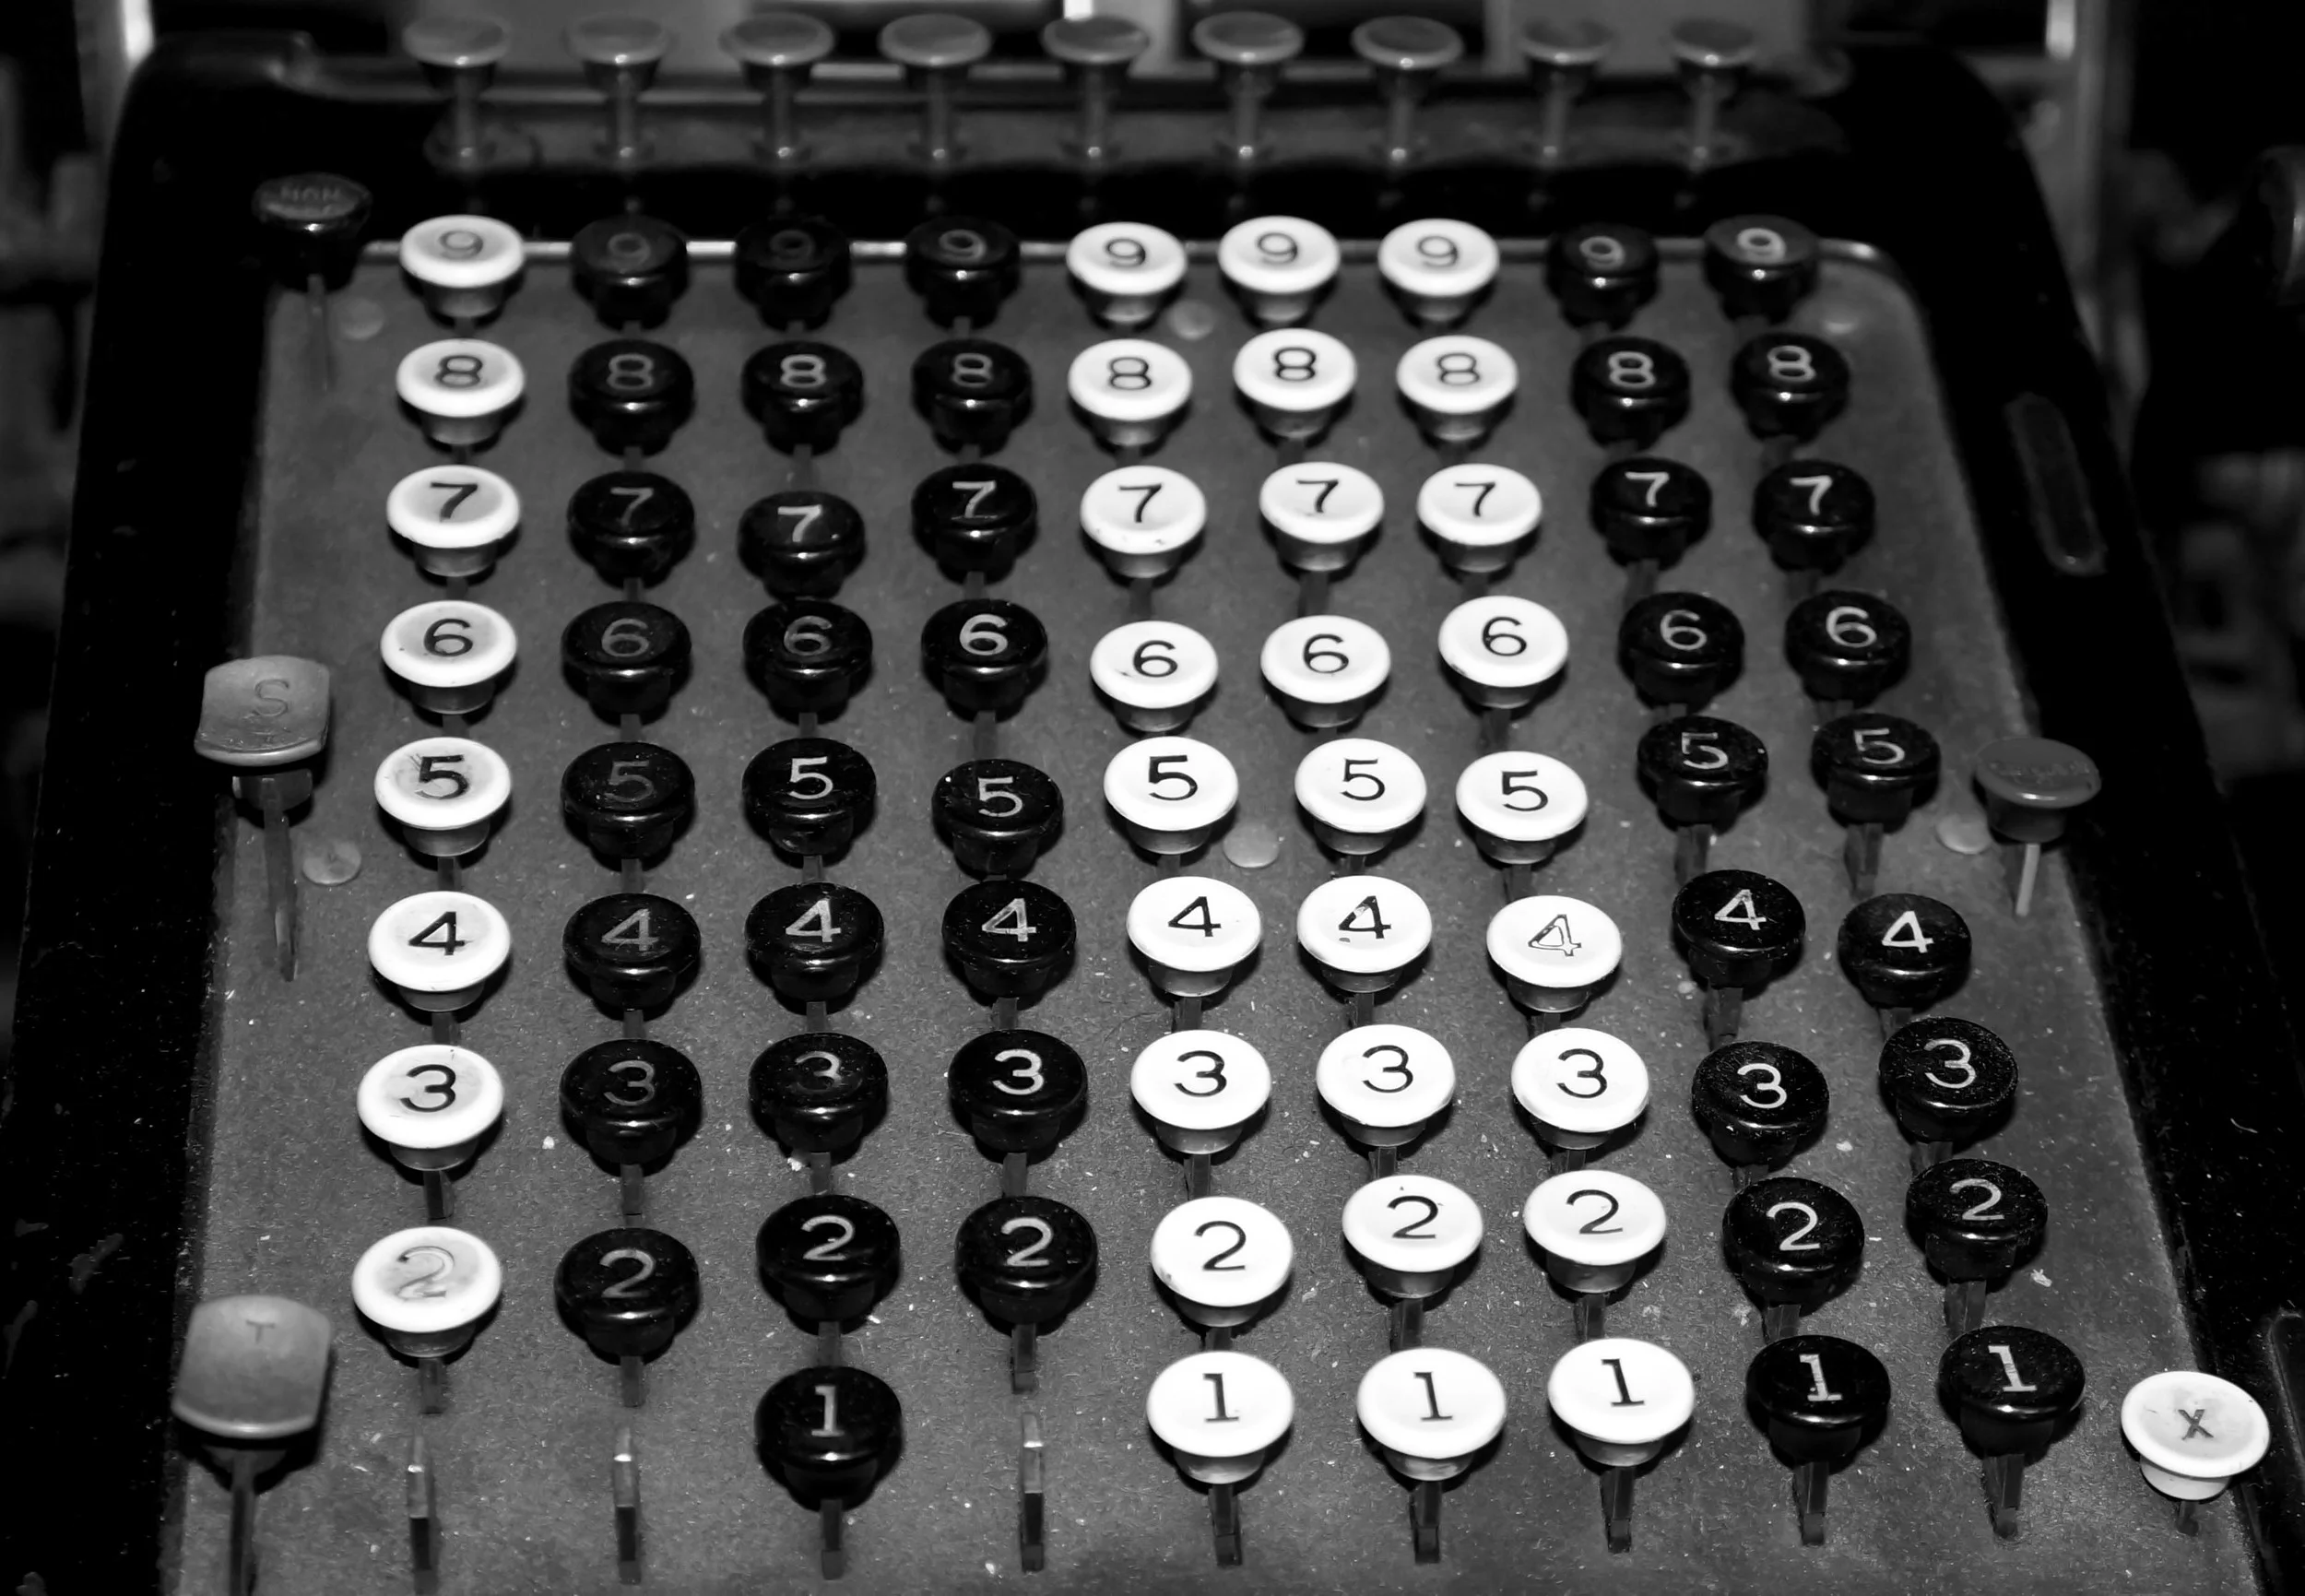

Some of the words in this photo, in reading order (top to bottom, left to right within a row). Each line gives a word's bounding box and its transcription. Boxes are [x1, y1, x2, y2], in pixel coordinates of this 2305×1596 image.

[439, 231, 484, 260] 9
[940, 230, 987, 264] 9
[1104, 238, 1147, 269] 9
[1256, 232, 1300, 265] 9
[1415, 235, 1460, 267] 9
[1579, 237, 1625, 268] 9
[1738, 228, 1785, 263] 9
[434, 355, 484, 388] 8
[609, 354, 653, 389] 8
[781, 354, 826, 388] 8
[952, 353, 992, 387] 8
[1108, 358, 1152, 390] 8
[1272, 347, 1317, 382] 8
[1436, 352, 1481, 384] 8
[1608, 351, 1656, 388] 8
[1767, 346, 1815, 382] 8
[431, 482, 479, 523] 7
[610, 487, 654, 526] 7
[952, 480, 996, 518] 7
[1119, 483, 1162, 523] 7
[1297, 479, 1339, 514] 7
[1456, 482, 1495, 517] 7
[1625, 472, 1669, 506] 7
[1791, 476, 1832, 514] 7
[778, 504, 822, 542] 7
[424, 619, 473, 656] 6
[602, 618, 650, 657] 6
[784, 616, 833, 657] 6
[960, 614, 1008, 656] 6
[1482, 617, 1527, 656] 6
[1661, 610, 1707, 651] 6
[1826, 607, 1876, 647] 6
[1133, 640, 1177, 678] 6
[1303, 633, 1349, 674] 6
[251, 679, 290, 717] S
[1682, 732, 1728, 769] 5
[1854, 728, 1905, 764] 5
[419, 755, 469, 799] 5
[607, 760, 654, 801] 5
[789, 756, 833, 799] 5
[978, 776, 1022, 817] 5
[1149, 755, 1198, 800] 5
[1342, 759, 1385, 801] 5
[1502, 771, 1548, 811] 5
[786, 898, 841, 942] 4
[982, 898, 1036, 941] 4
[1168, 896, 1221, 937] 4
[1339, 896, 1391, 941] 4
[1715, 890, 1767, 930] 4
[408, 912, 467, 955] 4
[602, 909, 658, 955] 4
[1528, 915, 1581, 957] 4
[1882, 911, 1933, 952] 4
[605, 1059, 655, 1105] 3
[796, 1051, 844, 1090] 3
[993, 1049, 1044, 1094] 3
[1175, 1050, 1227, 1097] 3
[1363, 1045, 1413, 1093] 3
[1557, 1048, 1607, 1098] 3
[1924, 1038, 1976, 1089] 3
[400, 1064, 456, 1112] 3
[1737, 1063, 1787, 1108] 3
[1388, 1196, 1438, 1239] 2
[1566, 1189, 1623, 1234] 2
[1951, 1178, 2004, 1221] 2
[802, 1215, 854, 1260] 2
[1002, 1217, 1053, 1266] 2
[1195, 1221, 1246, 1271] 2
[1767, 1201, 1820, 1250] 2
[394, 1246, 455, 1301] 2
[600, 1248, 655, 1297] 2
[245, 1318, 276, 1345] T
[1602, 1359, 1644, 1406] 1
[1800, 1354, 1841, 1401] 1
[1988, 1345, 2037, 1391] 1
[811, 1385, 842, 1436] 1
[1204, 1373, 1239, 1422] 1
[1414, 1372, 1452, 1421] 1
